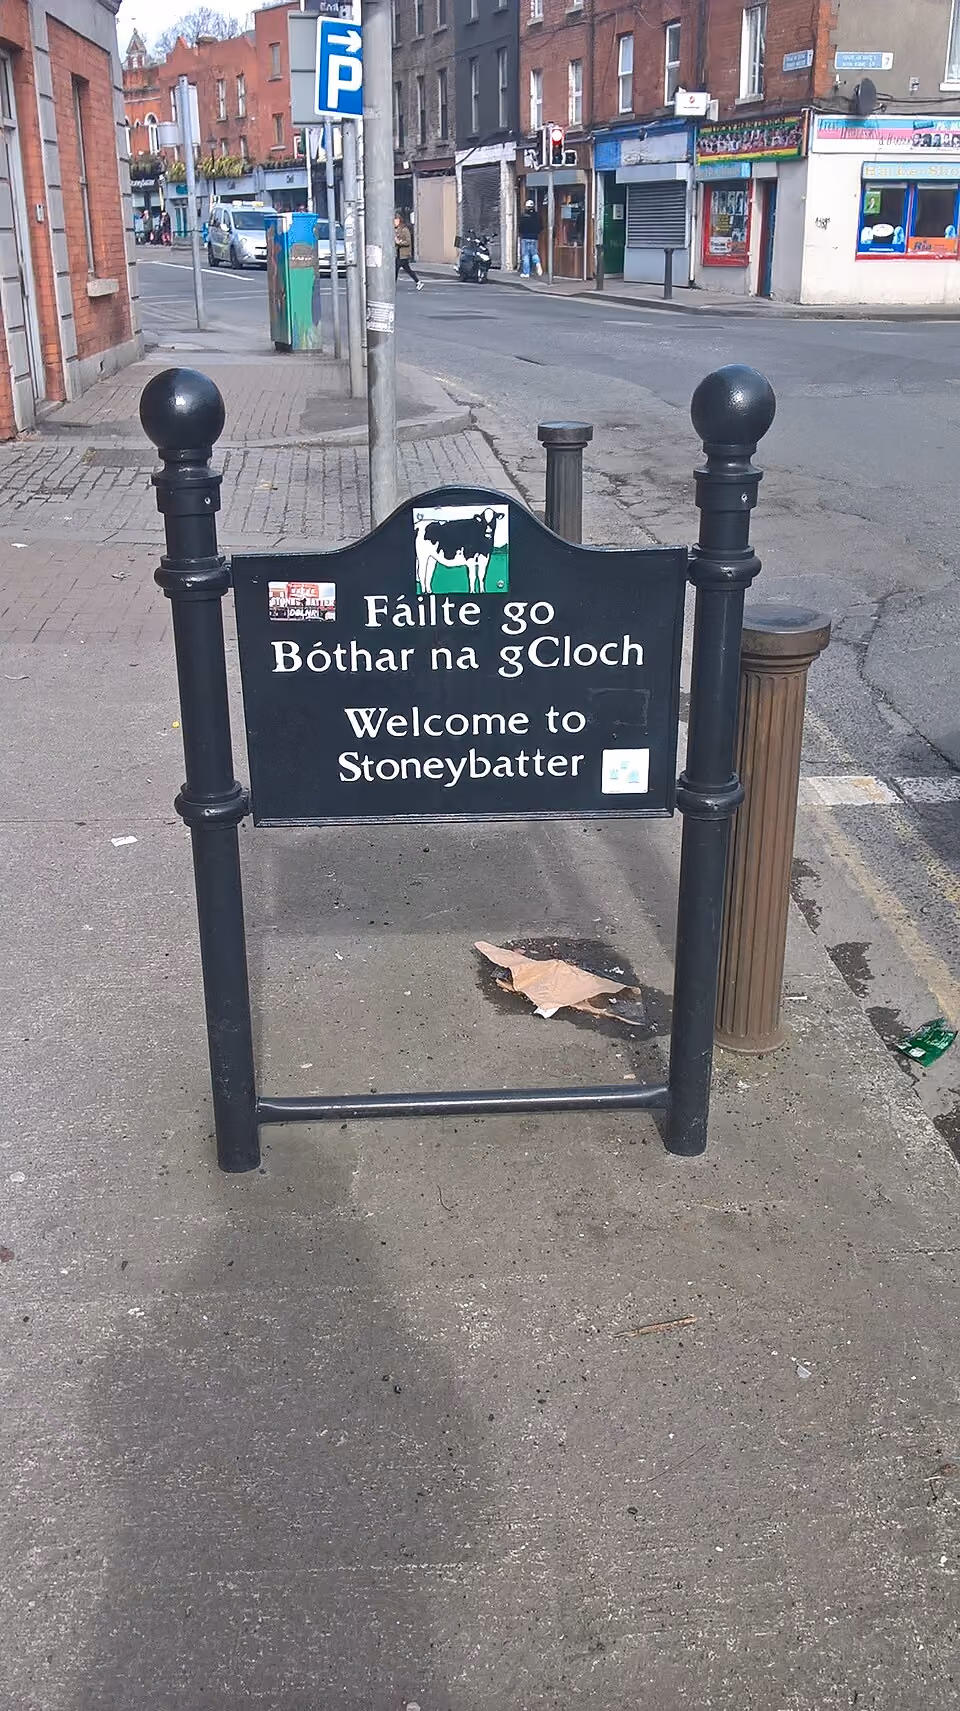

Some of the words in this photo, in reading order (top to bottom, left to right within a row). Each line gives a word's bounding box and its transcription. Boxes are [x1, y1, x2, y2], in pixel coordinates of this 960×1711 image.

[327, 53, 362, 109] P
[363, 594, 481, 627] Fáilte
[501, 601, 555, 635] go
[270, 640, 415, 674] Bóthar
[430, 647, 481, 671] na
[497, 635, 644, 678] gCloch
[344, 706, 530, 739] Welcome
[544, 705, 586, 734] to
[338, 747, 586, 788] Stoneybatter
